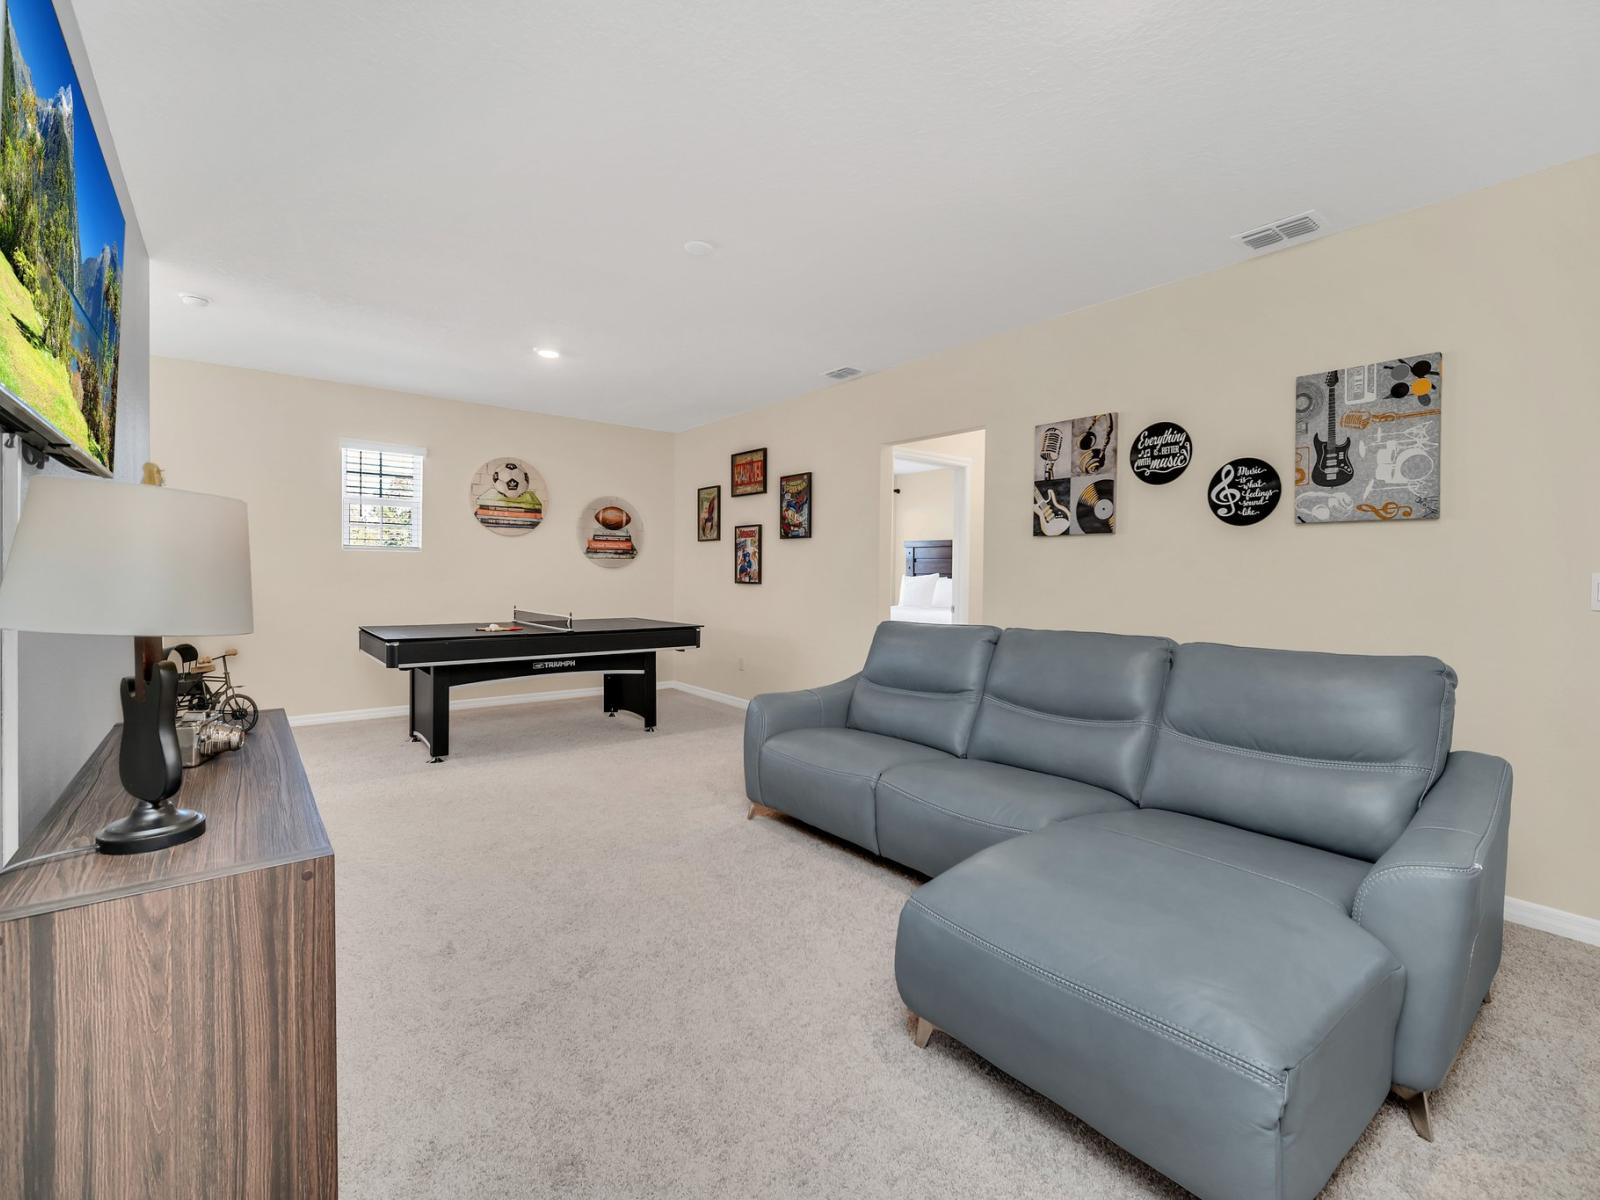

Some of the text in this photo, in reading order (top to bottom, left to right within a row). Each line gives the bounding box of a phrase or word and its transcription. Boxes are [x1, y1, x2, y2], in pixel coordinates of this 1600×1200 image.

[1138, 428, 1186, 450] Everything
[1150, 455, 1184, 470] music
[1236, 465, 1267, 477] Music
[544, 660, 576, 669] TRIUMPH
